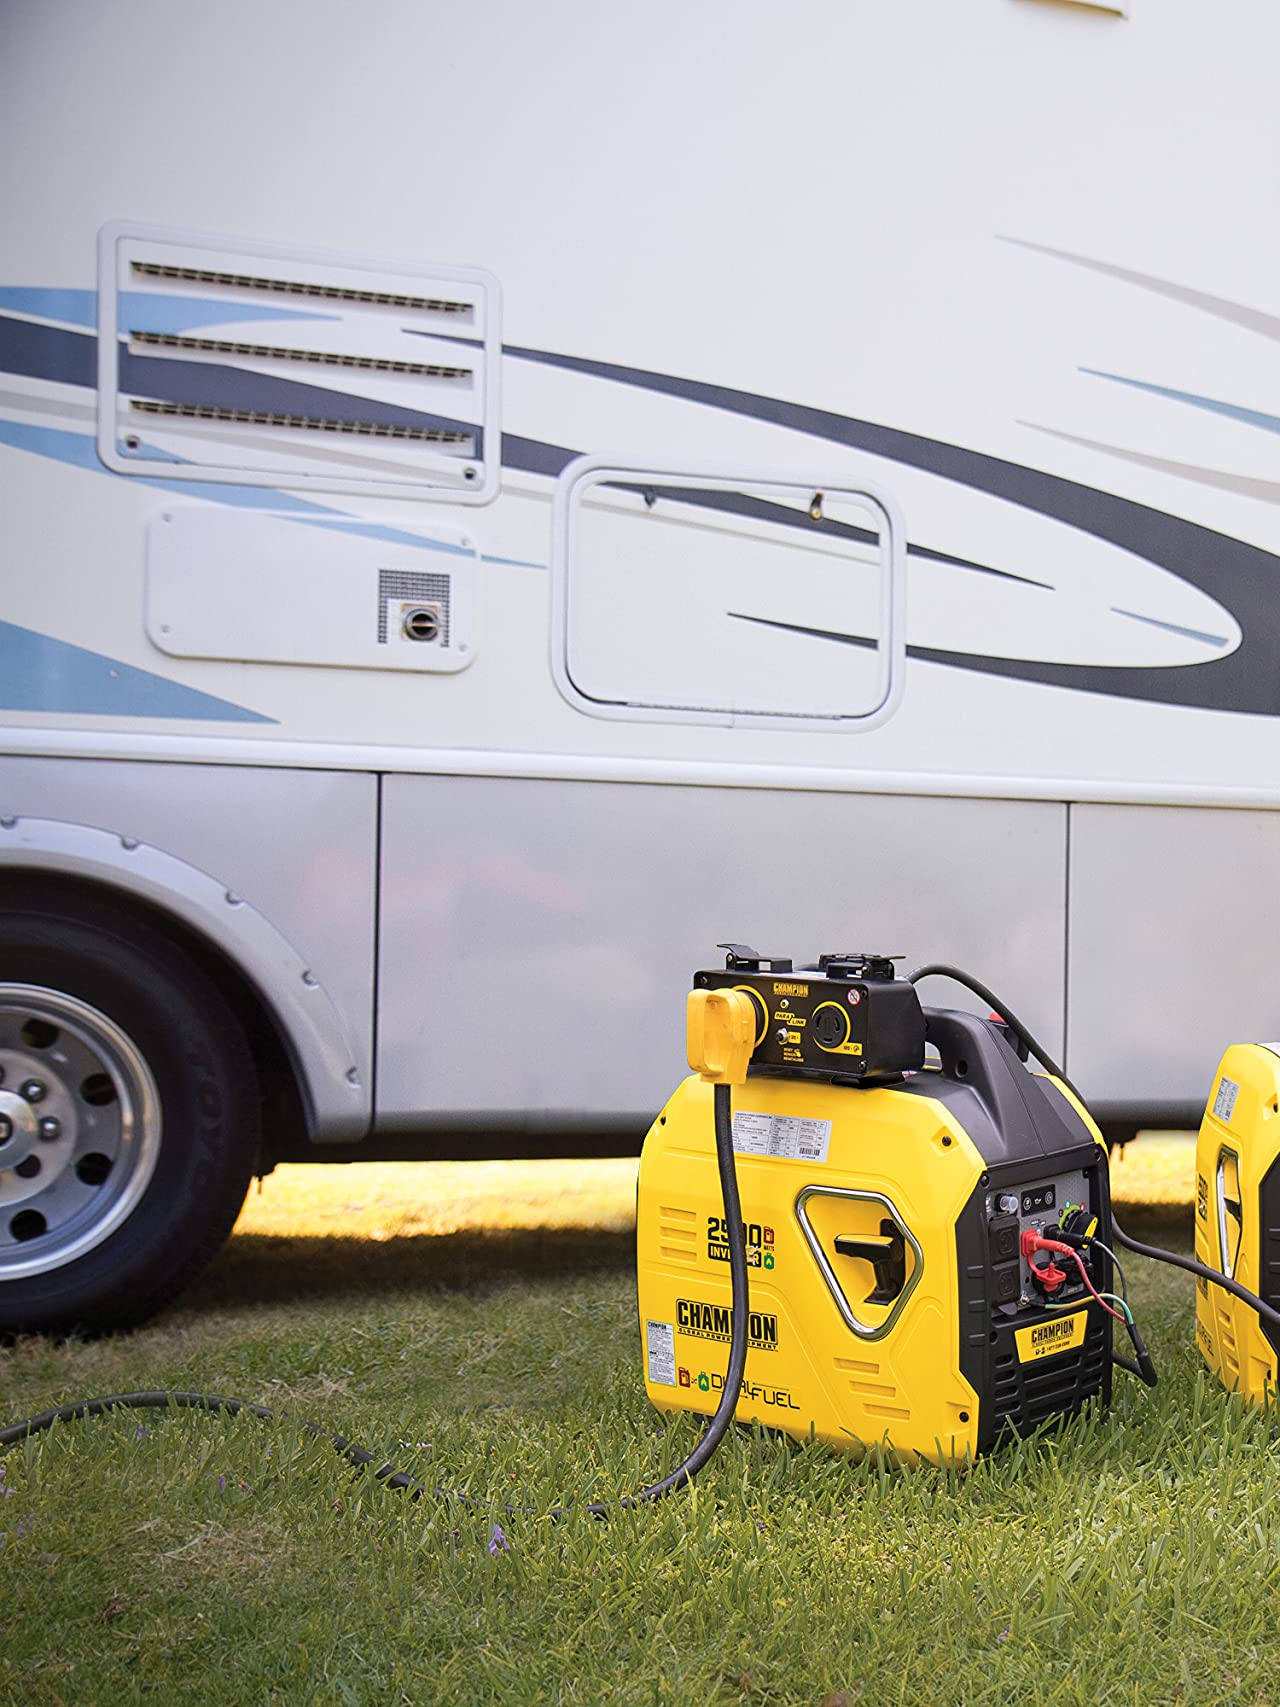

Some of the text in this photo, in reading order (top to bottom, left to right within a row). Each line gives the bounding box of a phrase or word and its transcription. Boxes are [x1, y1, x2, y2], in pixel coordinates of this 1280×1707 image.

[773, 982, 808, 996] CHAMPION
[677, 1300, 777, 1342] CHAMON
[679, 1327, 705, 1337] GLOBAL
[706, 1333, 731, 1342] POWER
[1032, 1319, 1074, 1343] CHAMPION
